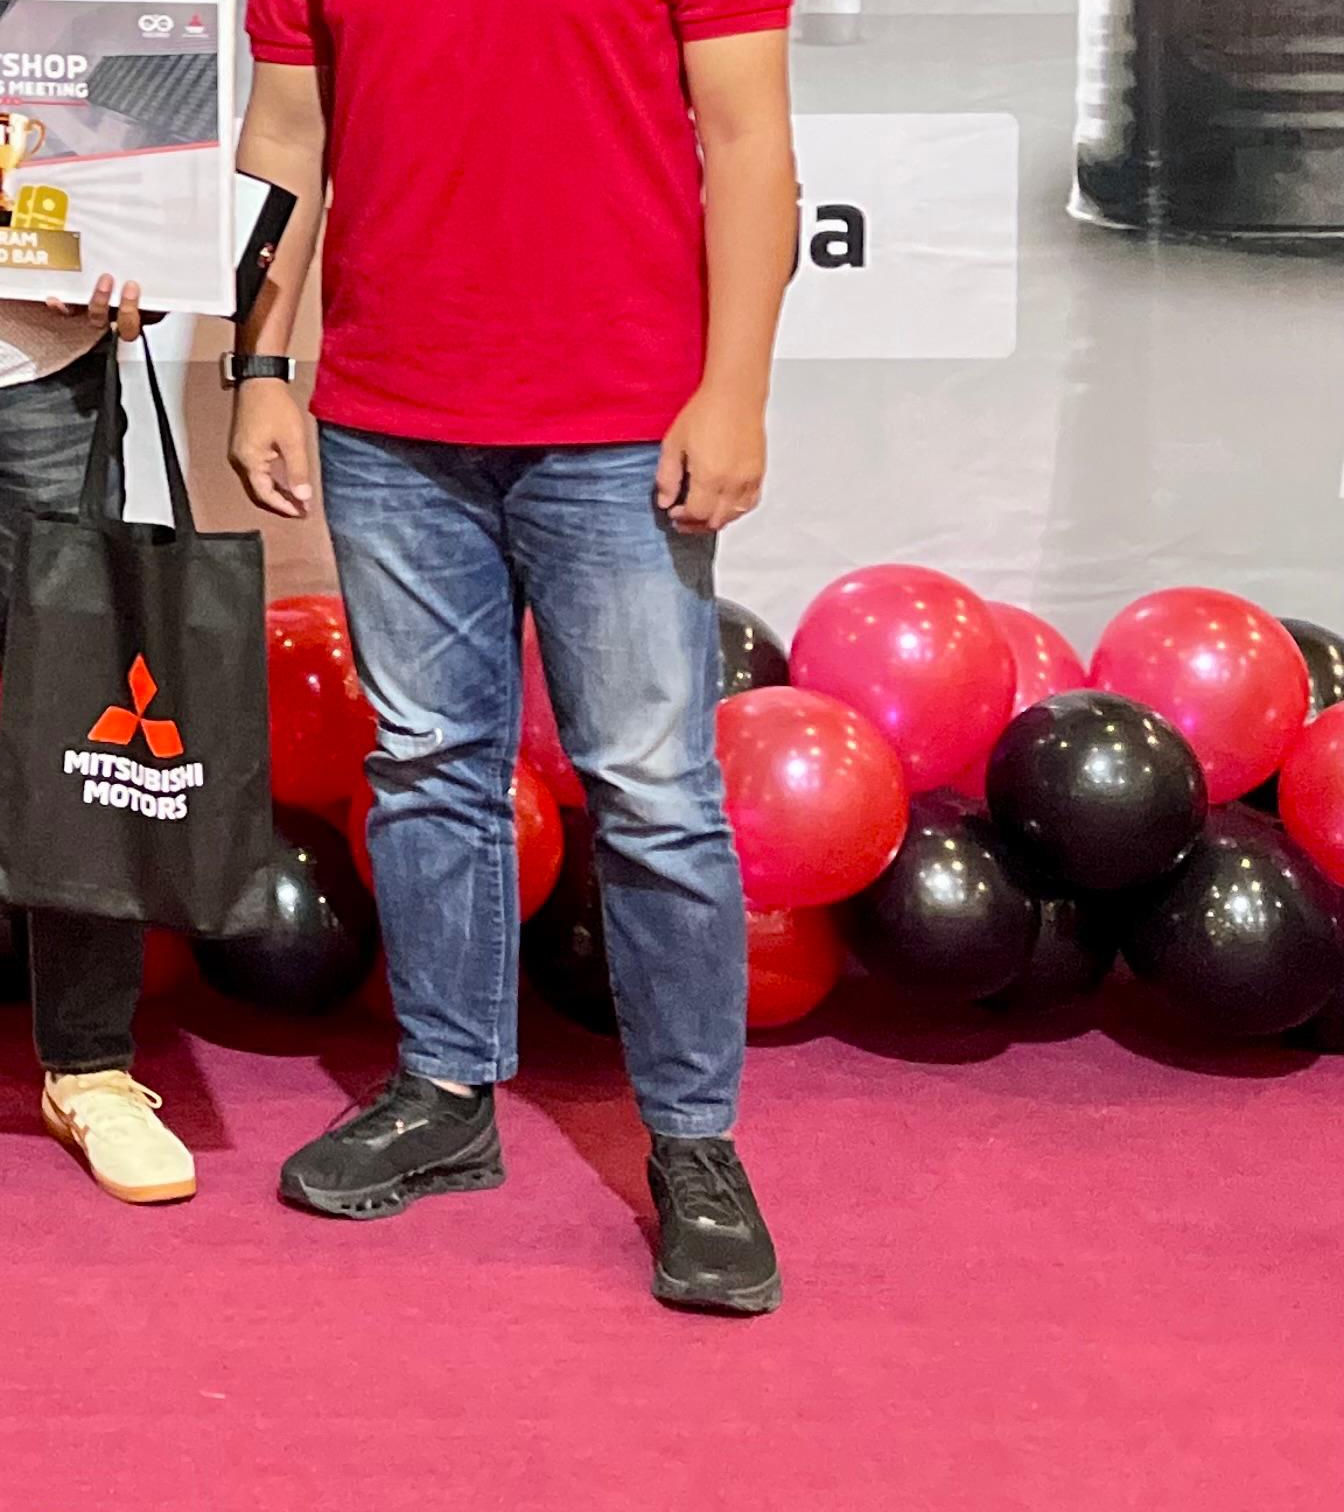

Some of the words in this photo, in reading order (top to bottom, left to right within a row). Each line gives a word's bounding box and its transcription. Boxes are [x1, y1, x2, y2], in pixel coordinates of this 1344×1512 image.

[9, 80, 89, 98] MEETING
[12, 249, 49, 265] BAR
[64, 750, 204, 792] MITSUBISHI
[83, 779, 187, 820] MOTORS
